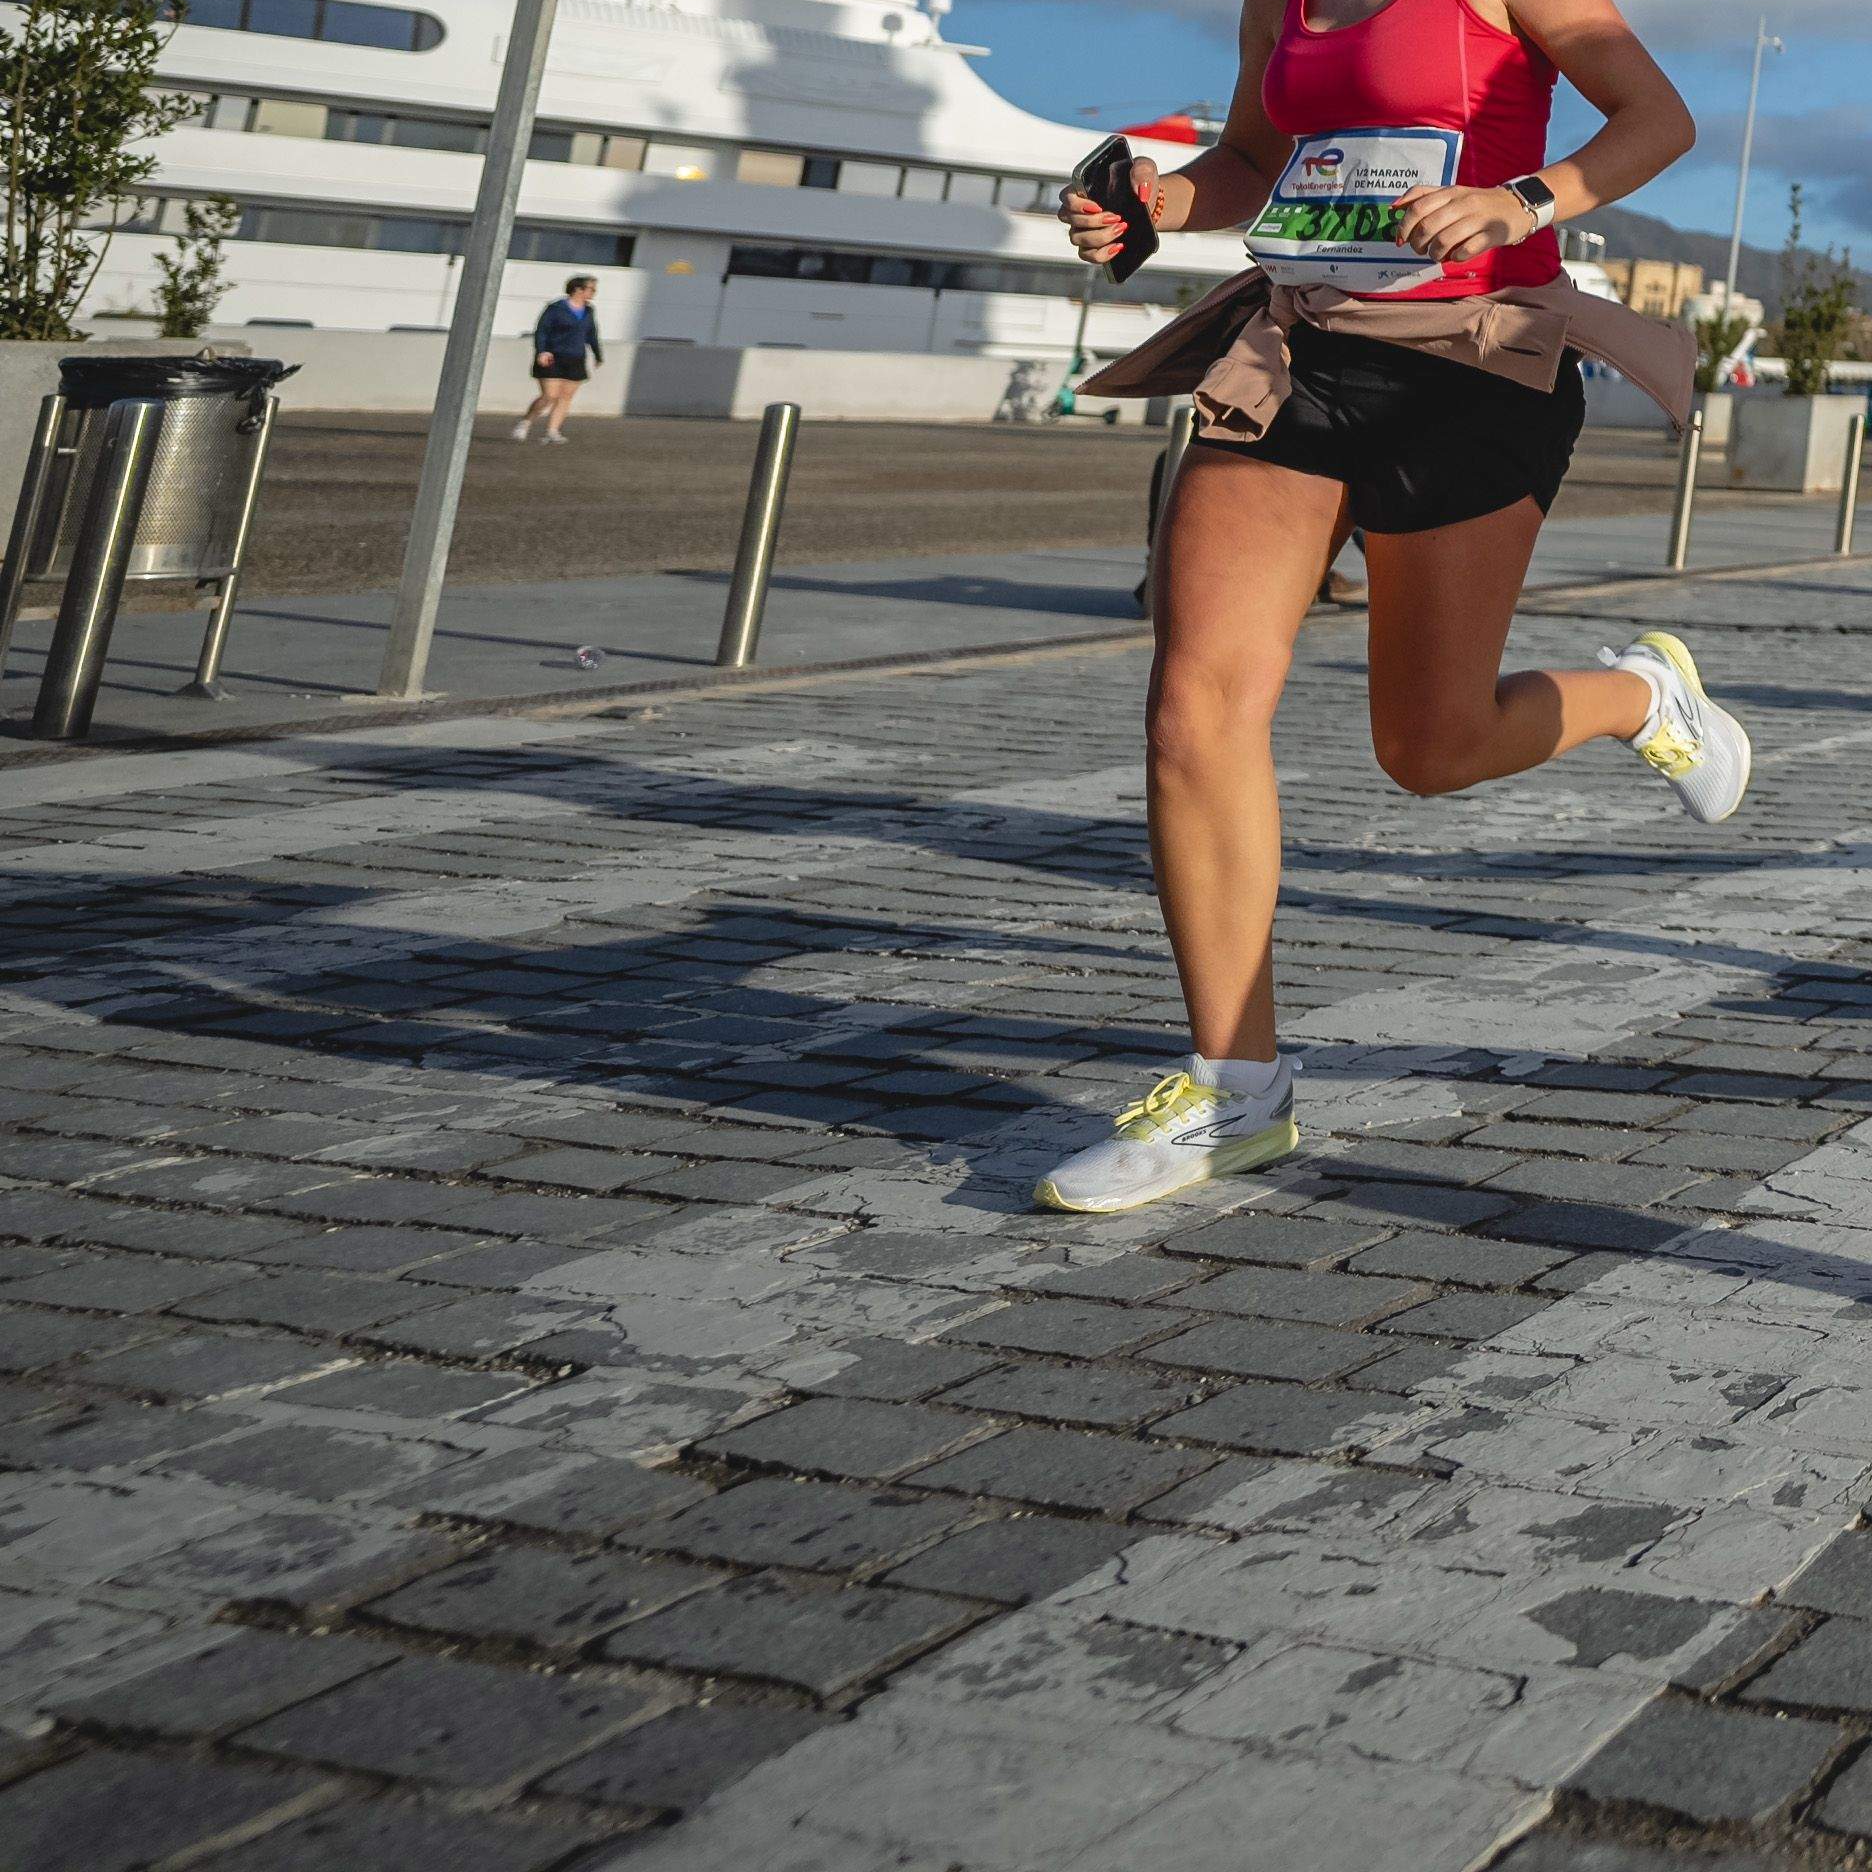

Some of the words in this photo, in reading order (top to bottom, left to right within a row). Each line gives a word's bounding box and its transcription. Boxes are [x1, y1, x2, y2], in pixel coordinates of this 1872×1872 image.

[1356, 169, 1369, 177] 1/2
[1370, 167, 1419, 178] MARATÓN
[1291, 182, 1344, 191] TotalEnergies
[1354, 180, 1367, 189] DE
[1369, 178, 1409, 189] MÁLAGA
